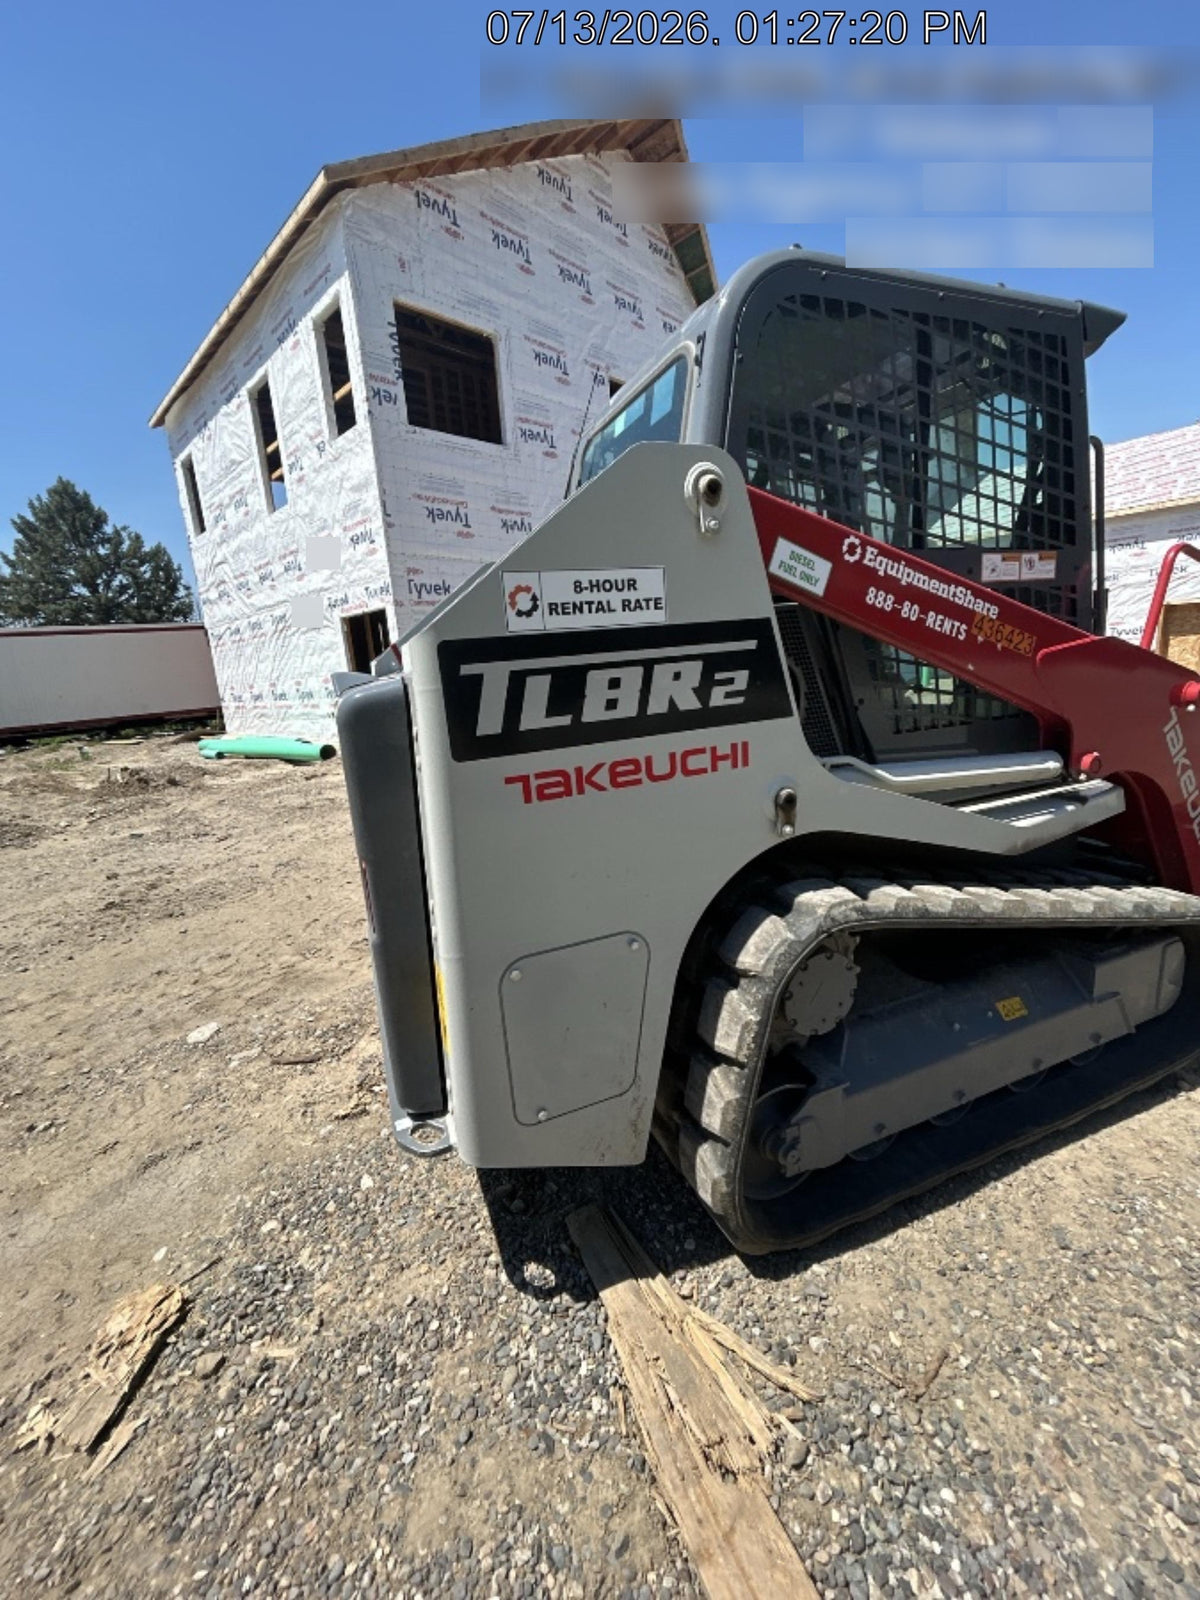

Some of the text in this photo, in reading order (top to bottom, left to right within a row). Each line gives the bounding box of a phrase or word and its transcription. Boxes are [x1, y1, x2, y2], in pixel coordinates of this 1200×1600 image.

[537, 166, 573, 202] Tyvek
[491, 228, 533, 266] Tyvek
[533, 349, 570, 377] Tyvek
[518, 427, 557, 450] Tyvek
[426, 506, 472, 529] Tyvek
[778, 560, 820, 588] FUEL ONLY
[789, 550, 816, 572] DIESEL
[408, 579, 450, 599] Tyvek
[573, 578, 638, 594] 8-HOUR
[863, 545, 999, 620] EquipmentShare
[548, 597, 664, 617] RENTAL RATE
[865, 586, 968, 641] 888-80-RENTS
[973, 615, 1034, 655] 436423
